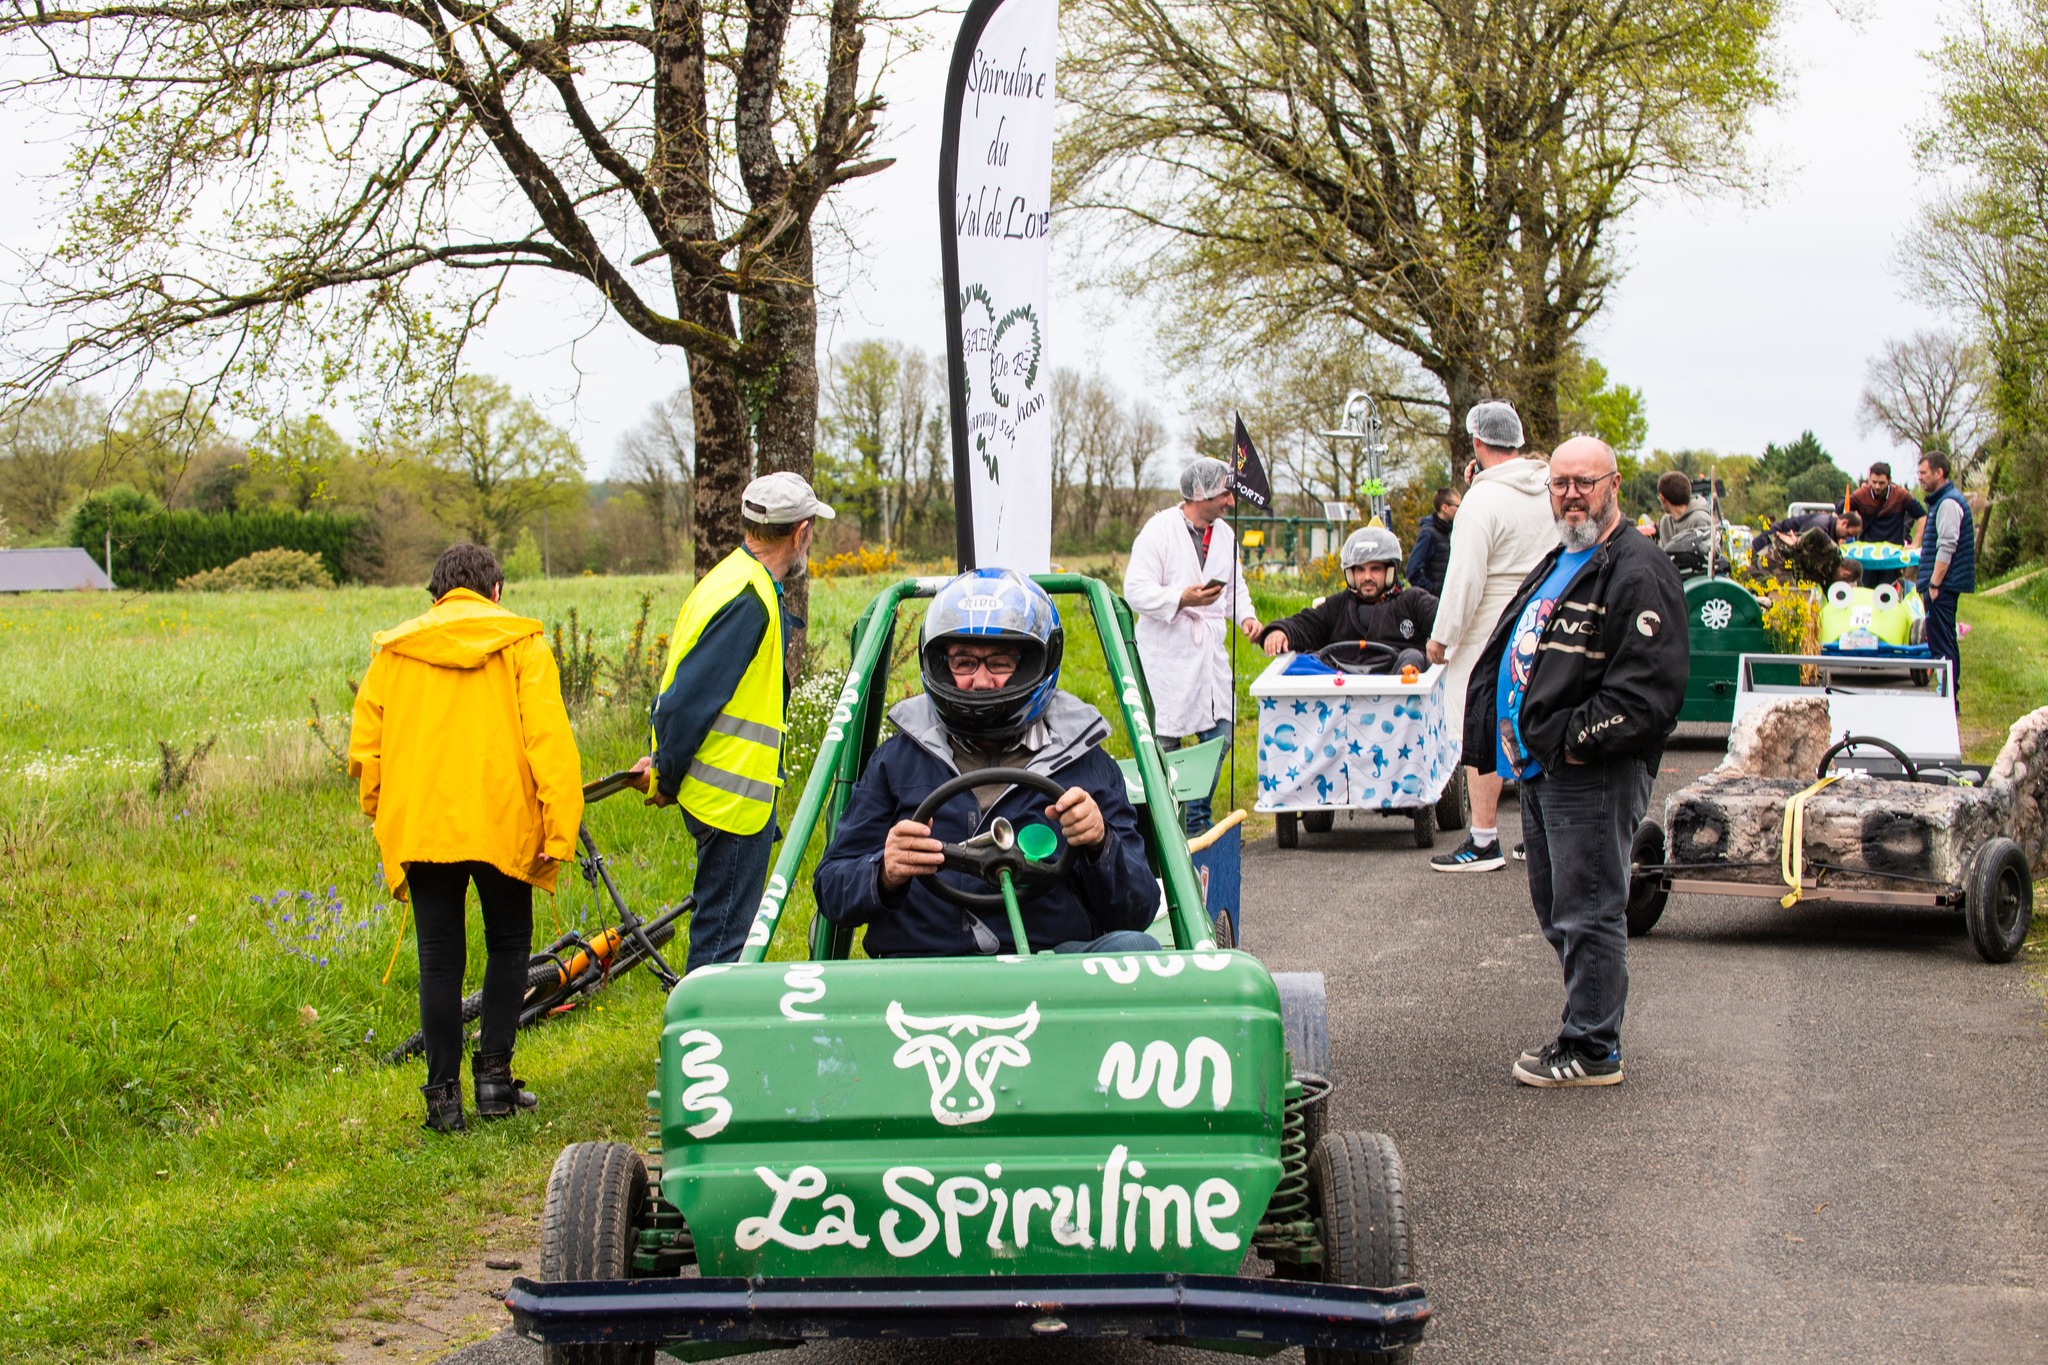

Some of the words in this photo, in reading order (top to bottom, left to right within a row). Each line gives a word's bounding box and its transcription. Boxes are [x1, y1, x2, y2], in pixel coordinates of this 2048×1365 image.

[967, 47, 1046, 118] Spiruline
[987, 115, 1009, 167] du
[957, 185, 987, 237] Val
[984, 186, 1002, 238] de
[962, 327, 993, 357] GAEC
[734, 1165, 870, 1251] La
